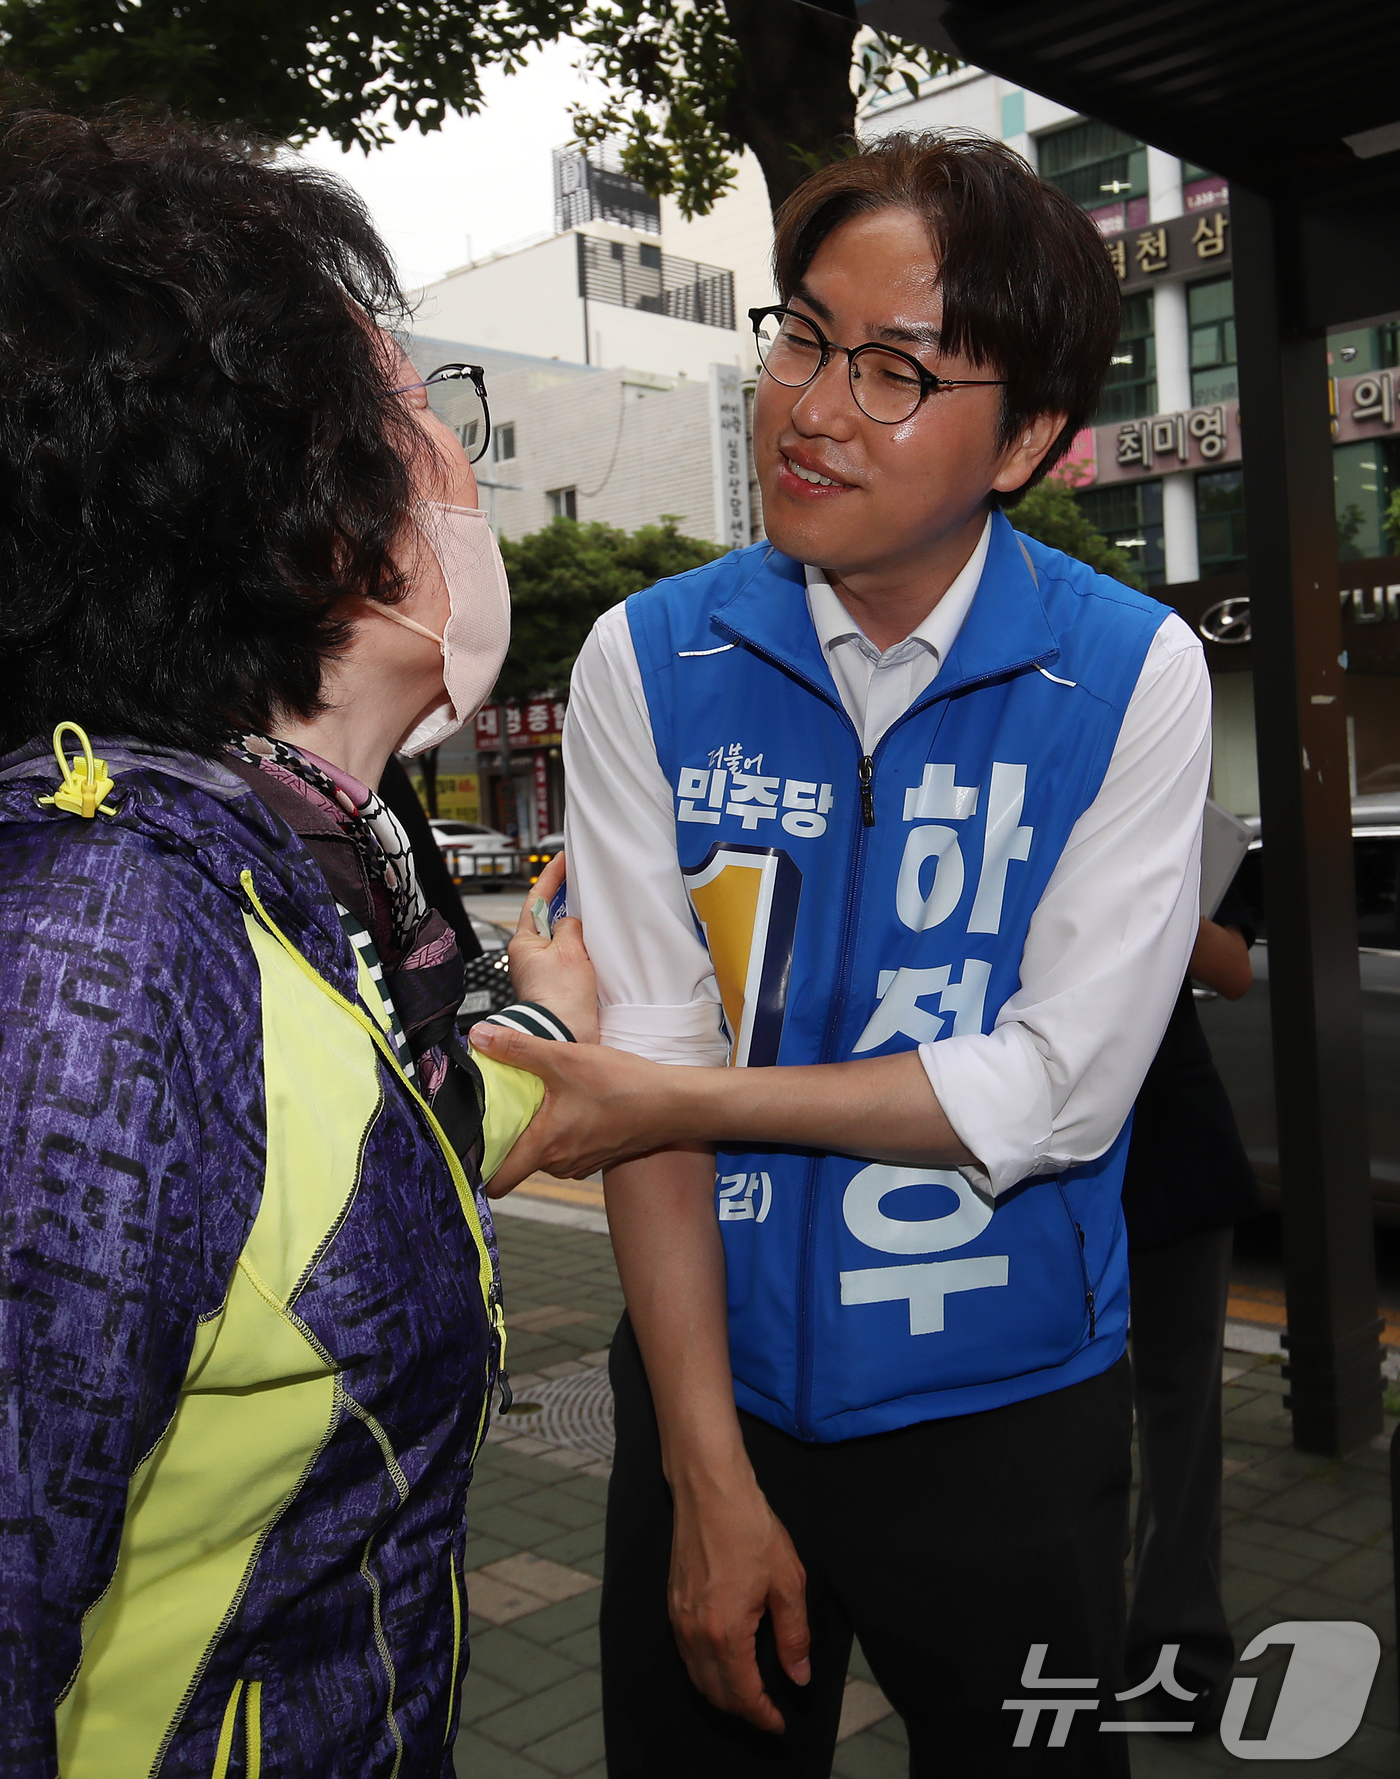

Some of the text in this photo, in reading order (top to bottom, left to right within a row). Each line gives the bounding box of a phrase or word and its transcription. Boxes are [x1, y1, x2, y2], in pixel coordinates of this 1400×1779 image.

[1191, 212, 1229, 258] 삼
[1117, 405, 1227, 468] 최미영
[1353, 376, 1400, 425] 의
[707, 742, 764, 775] 더불어
[677, 767, 834, 838] 민주당
[715, 1171, 773, 1223] 갑)
